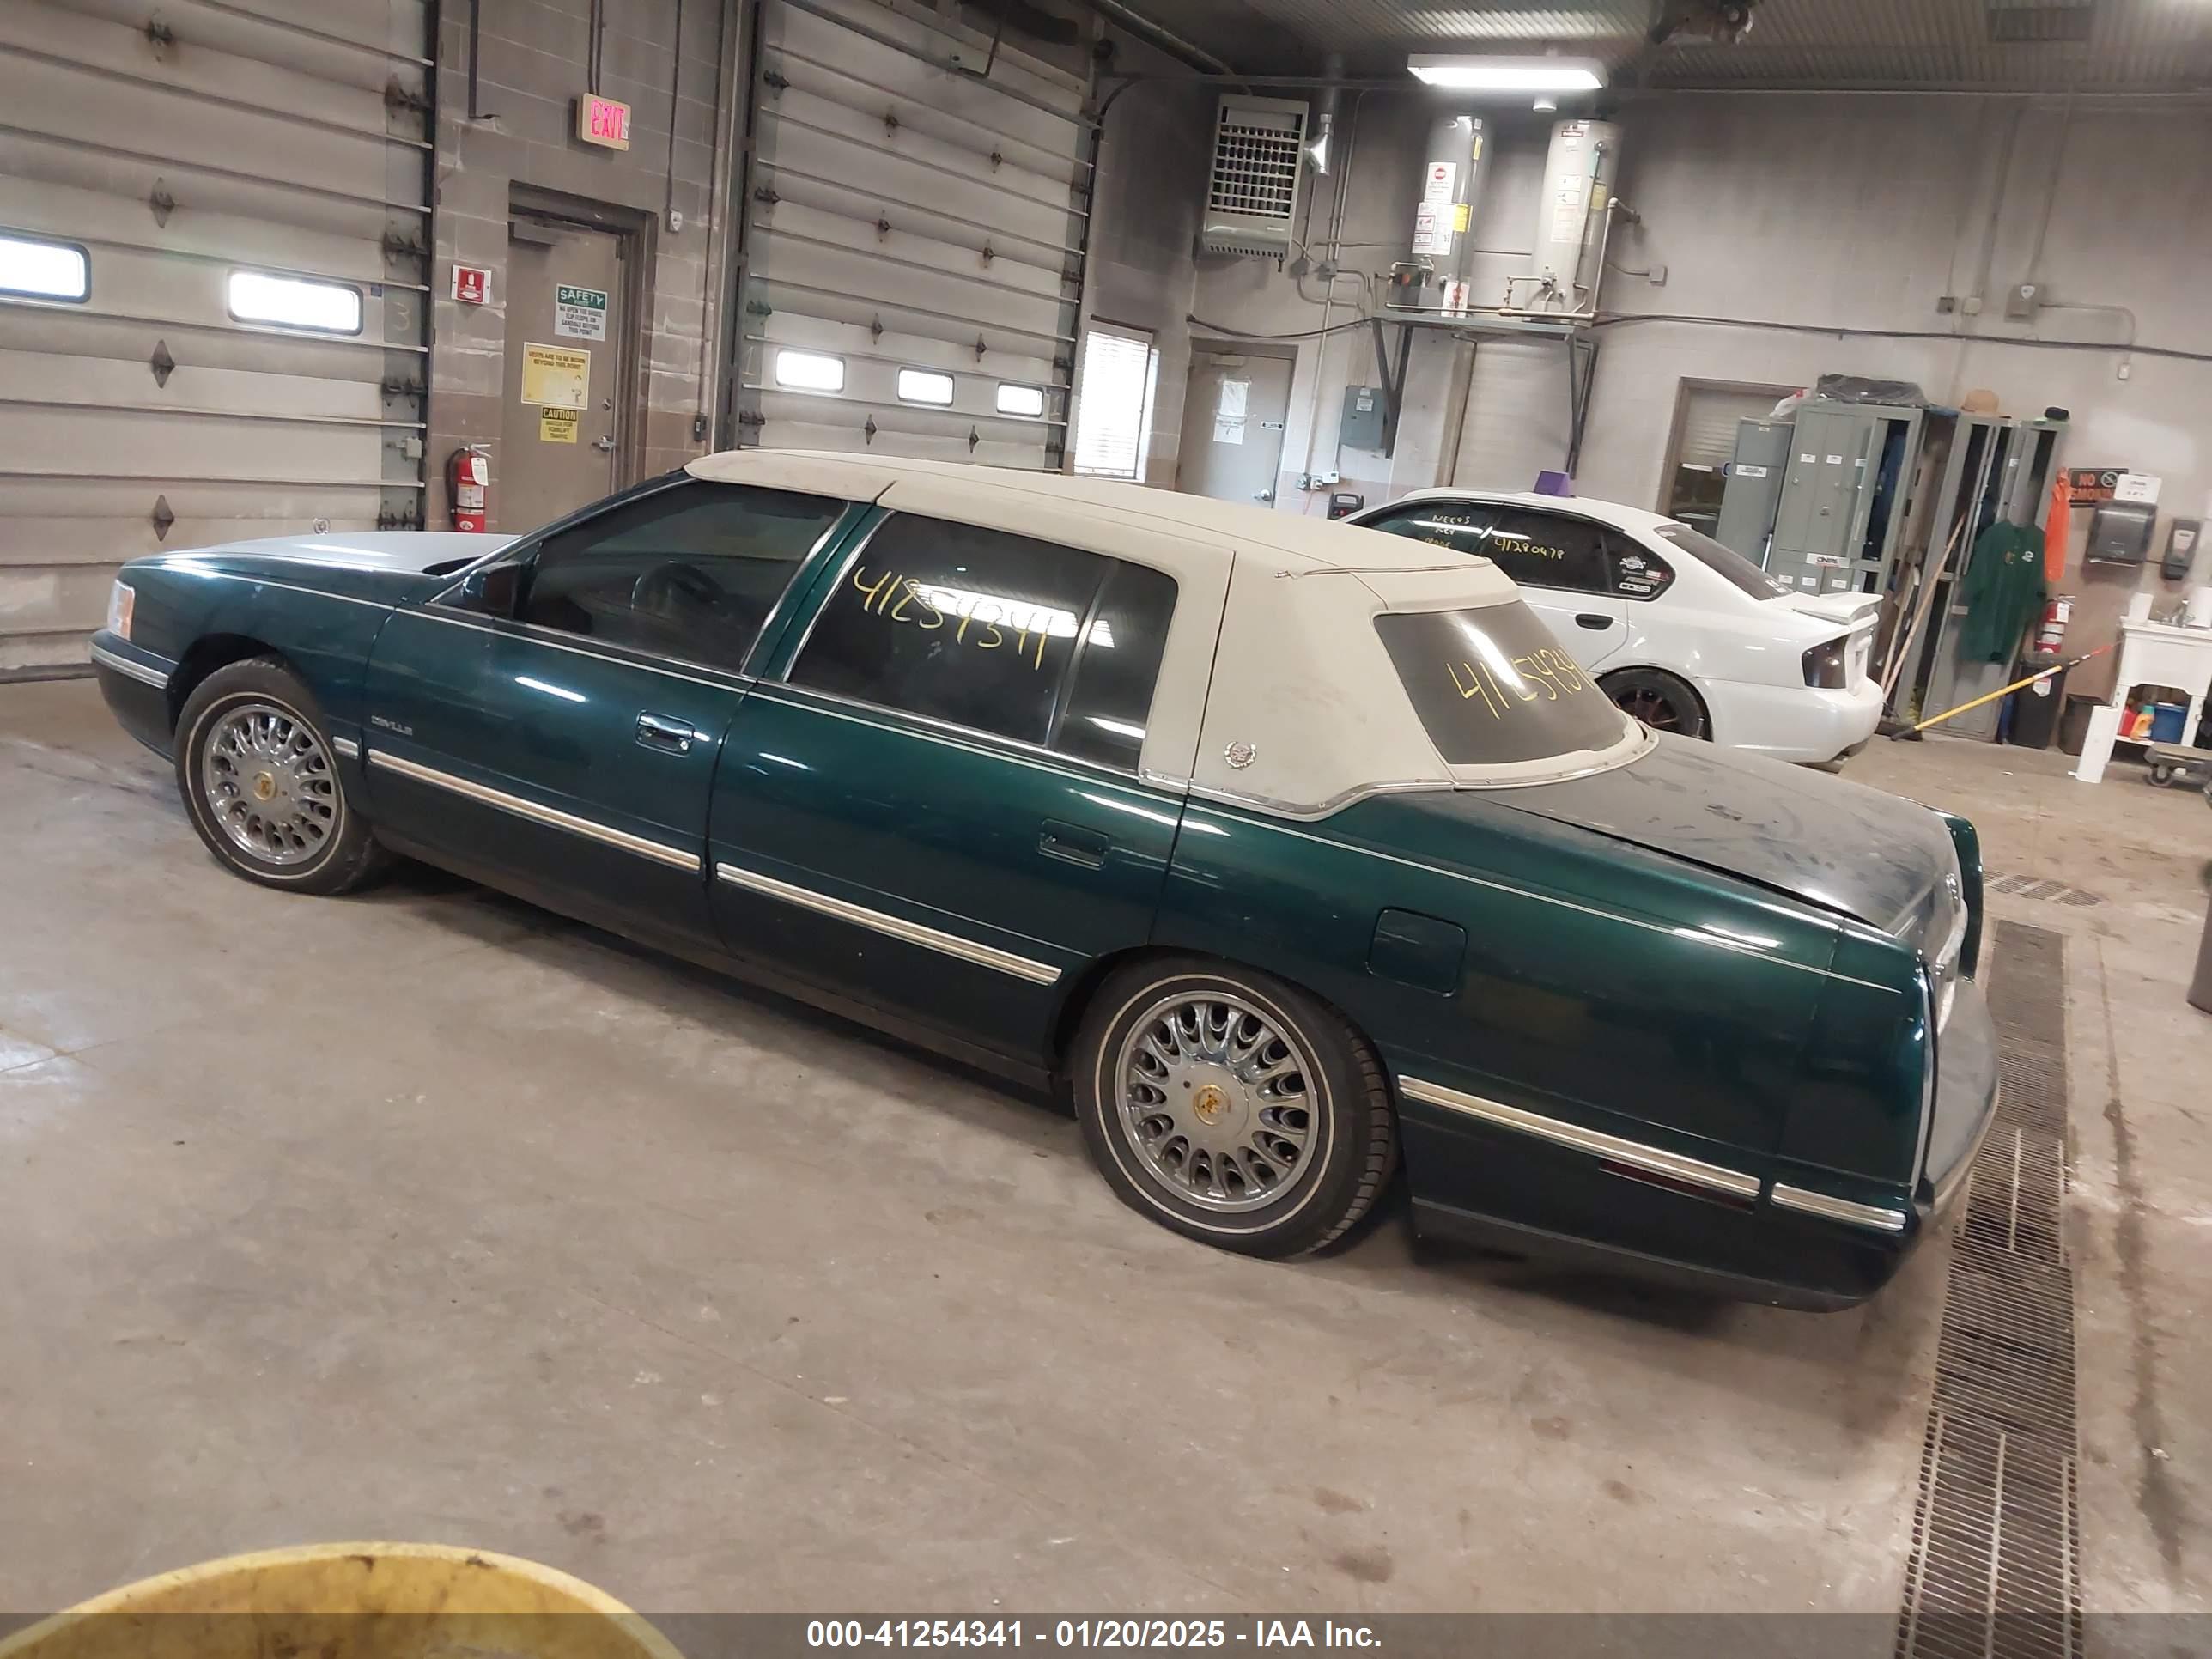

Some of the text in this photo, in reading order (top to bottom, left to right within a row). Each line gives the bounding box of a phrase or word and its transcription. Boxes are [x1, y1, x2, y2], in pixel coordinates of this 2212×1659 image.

[590, 100, 624, 139] EXIT
[560, 289, 604, 306] SAFETY
[543, 409, 577, 420] CAUTION
[2080, 473, 2095, 486] NO
[1494, 537, 1565, 560] 41280478
